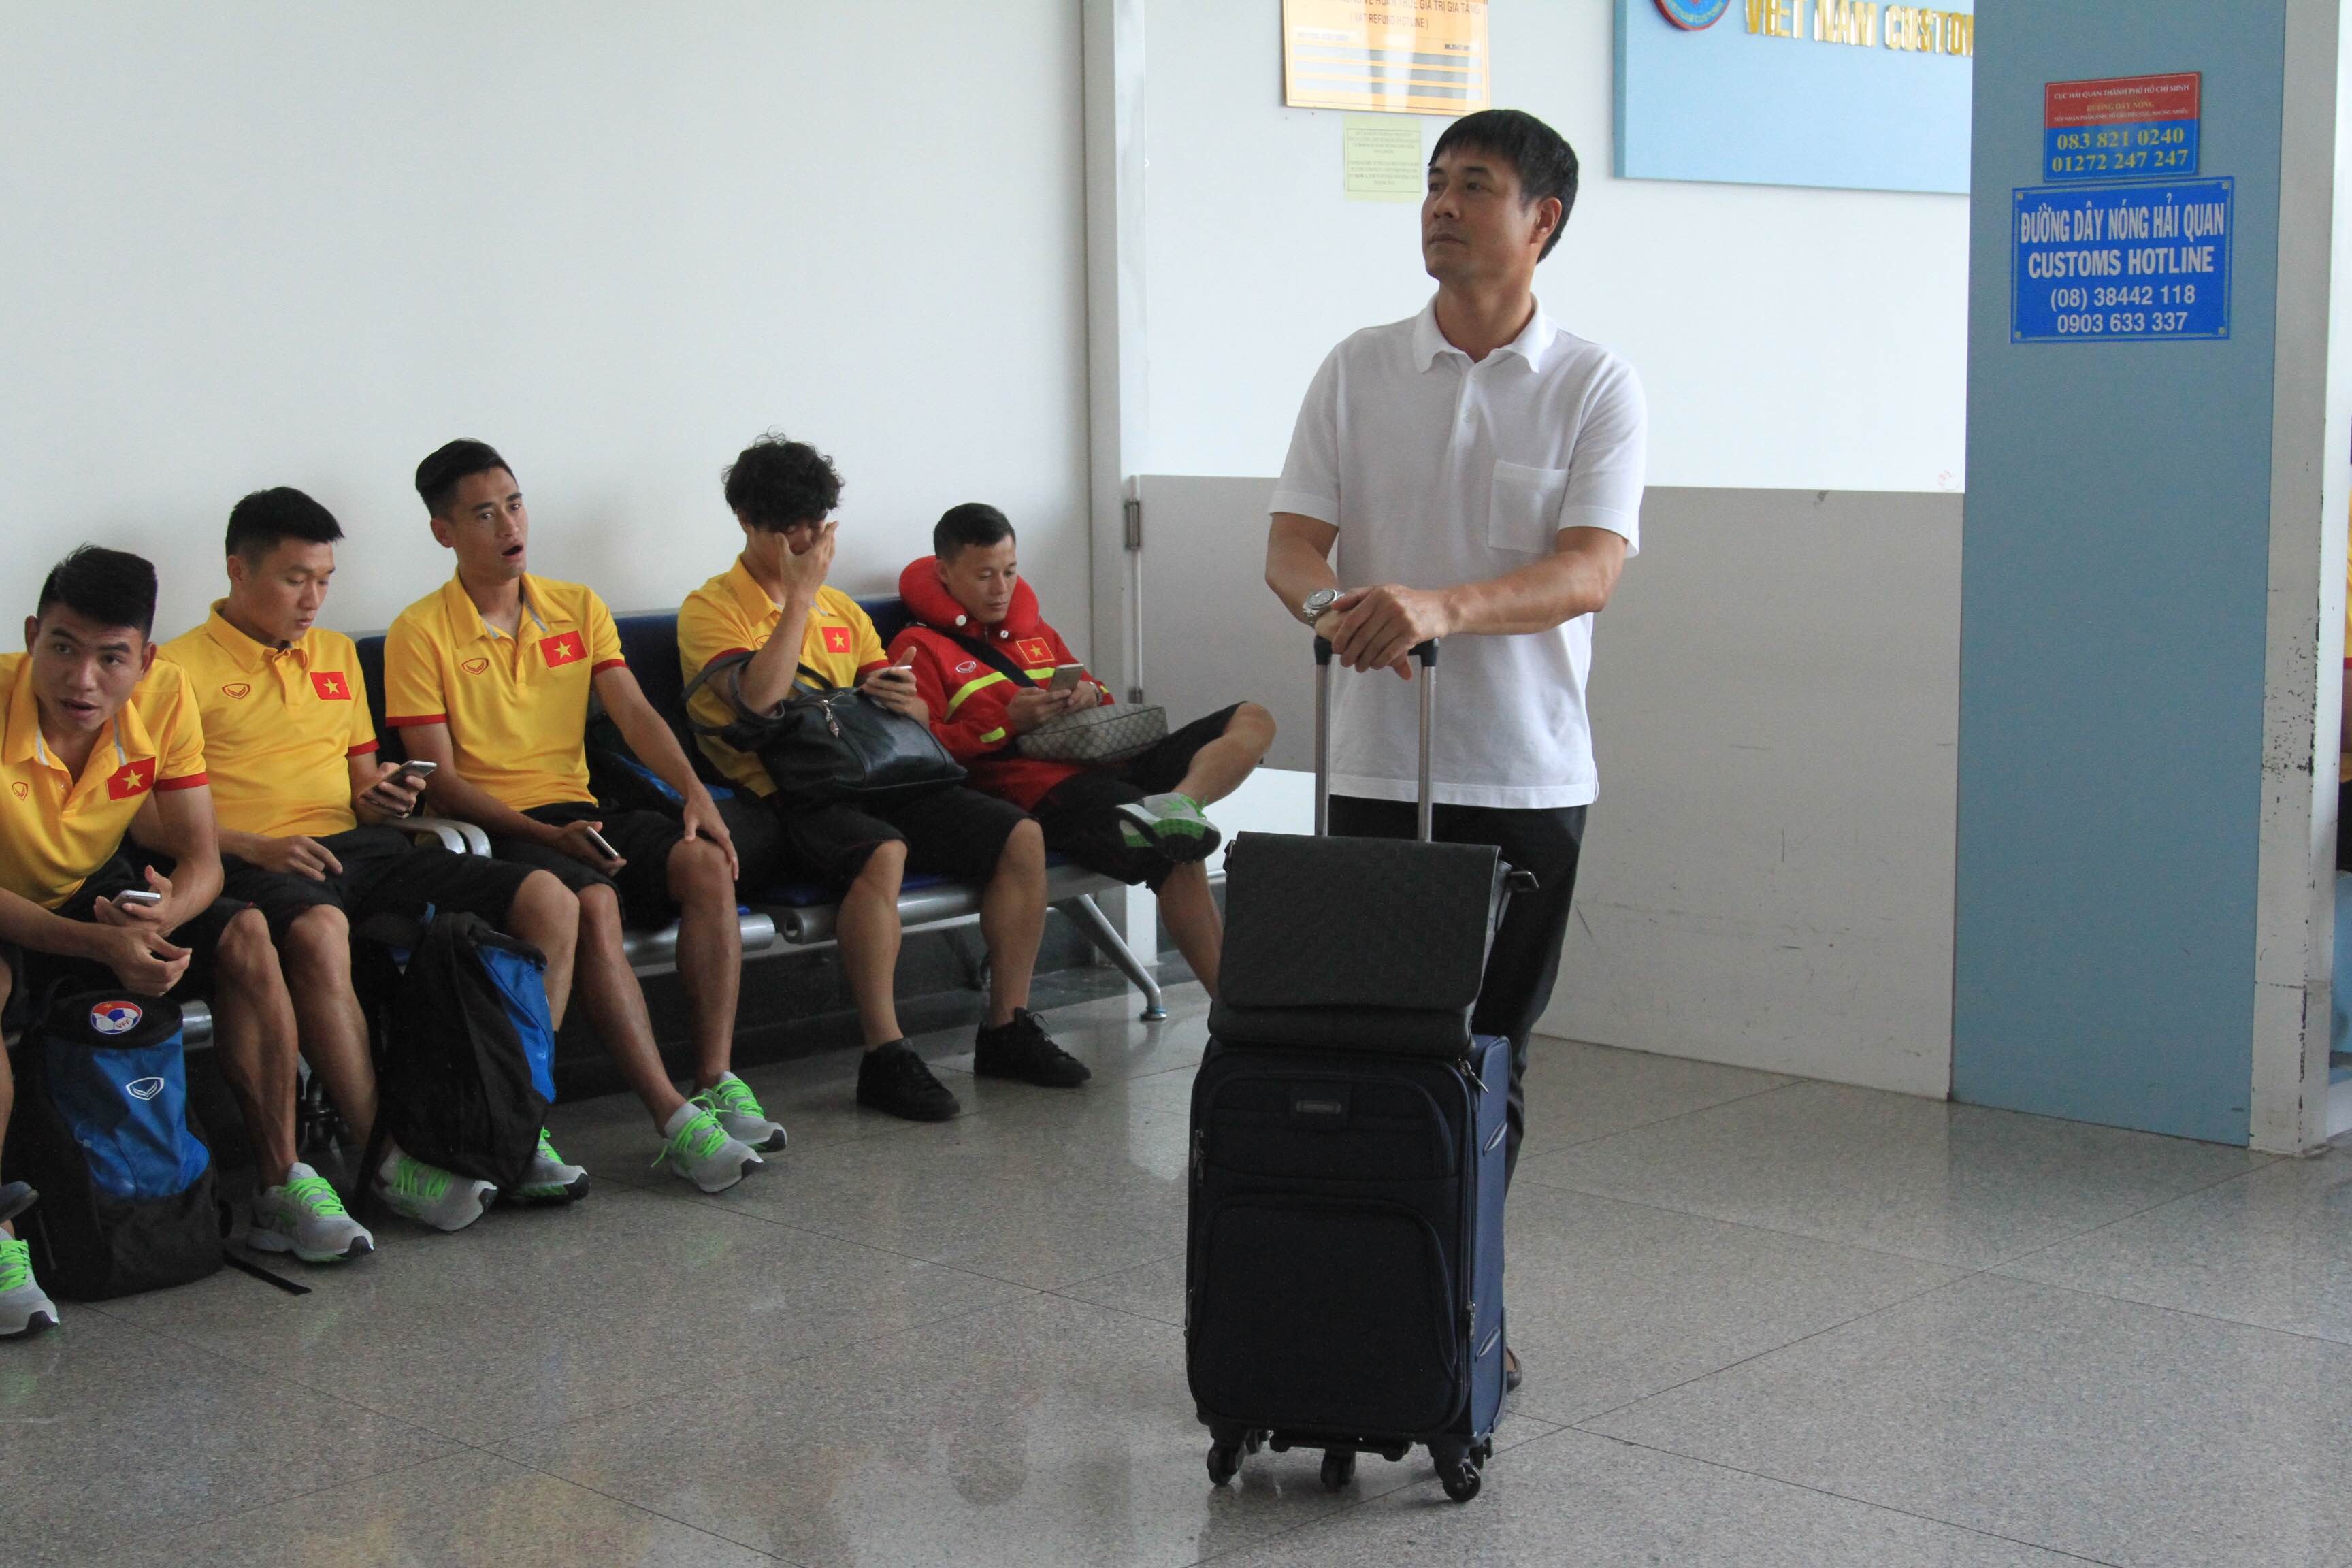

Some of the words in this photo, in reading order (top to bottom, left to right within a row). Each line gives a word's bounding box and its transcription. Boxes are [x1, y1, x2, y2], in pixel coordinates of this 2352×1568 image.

[1368, 14, 1394, 25] REFUND
[1396, 16, 1424, 28] HOTLINE
[1745, 0, 1803, 39] VIET
[1814, 0, 1877, 47] NAM
[2082, 90, 2102, 98] QUAN
[2170, 84, 2189, 93] MINH
[2057, 133, 2091, 150] 083
[2097, 130, 2129, 148] 821
[2137, 127, 2185, 146] 0240
[2052, 154, 2106, 172] 01272
[2114, 152, 2147, 169] 247
[2154, 149, 2189, 167] 247
[2021, 203, 2070, 243] ĐƯỜNG
[2074, 201, 2104, 241] DÂY
[2108, 199, 2149, 240] NÓNG
[2153, 193, 2179, 238] HẢI
[2183, 203, 2225, 242] QUAN
[2028, 249, 2121, 278] CUSTOMS
[2128, 246, 2215, 275] HOTLINE
[2050, 287, 2087, 312] (08)
[2093, 285, 2153, 306] 38442
[2160, 284, 2195, 304] 118
[2057, 314, 2104, 333] 0903
[2110, 312, 2145, 332] 633
[2152, 311, 2189, 331] 337
[116, 1018, 131, 1029] VFF
